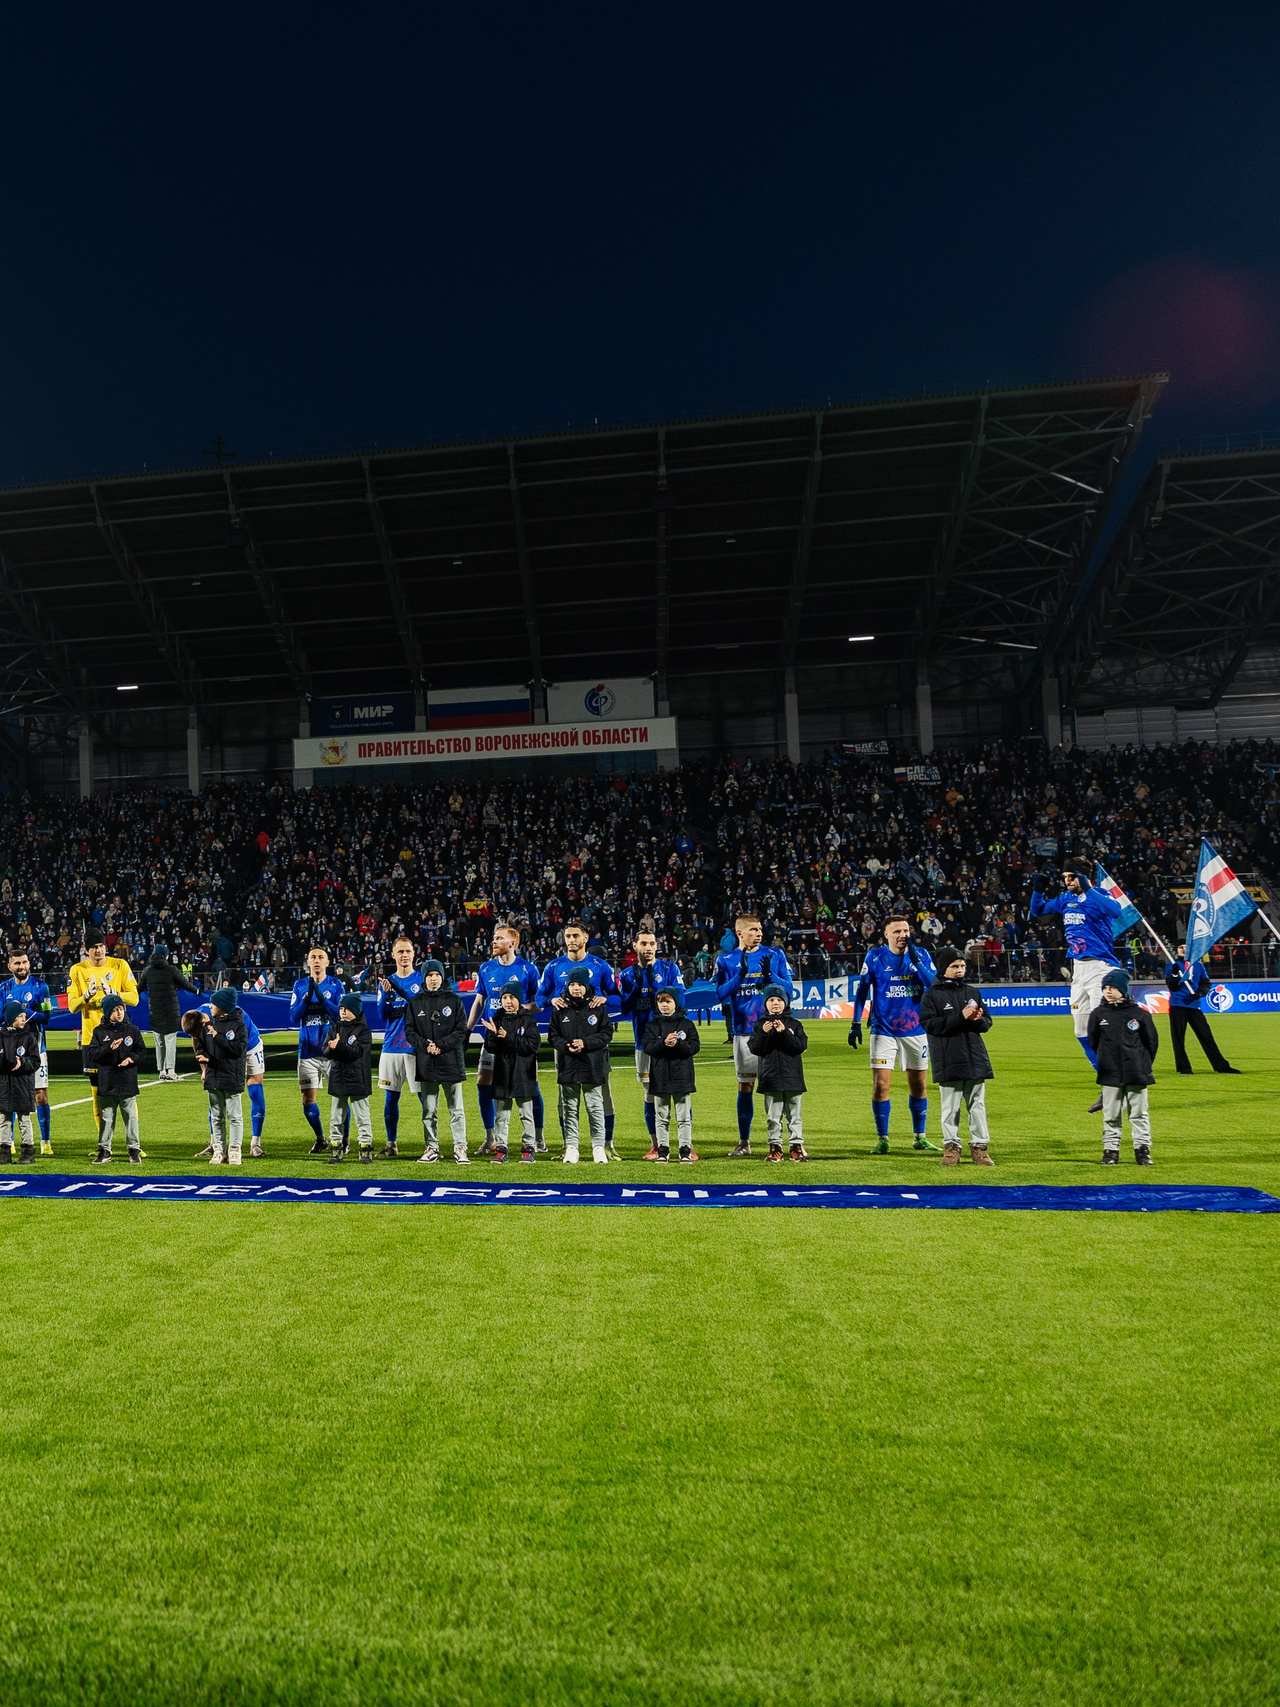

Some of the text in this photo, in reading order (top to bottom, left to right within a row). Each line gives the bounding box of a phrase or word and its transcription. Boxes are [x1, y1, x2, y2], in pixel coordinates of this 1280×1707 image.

[354, 705, 394, 719] МИР
[358, 727, 649, 758] ПРАВИТЕЛЬСТВО ВОРОНЕЖСКОЙ ОБЛАСТИ
